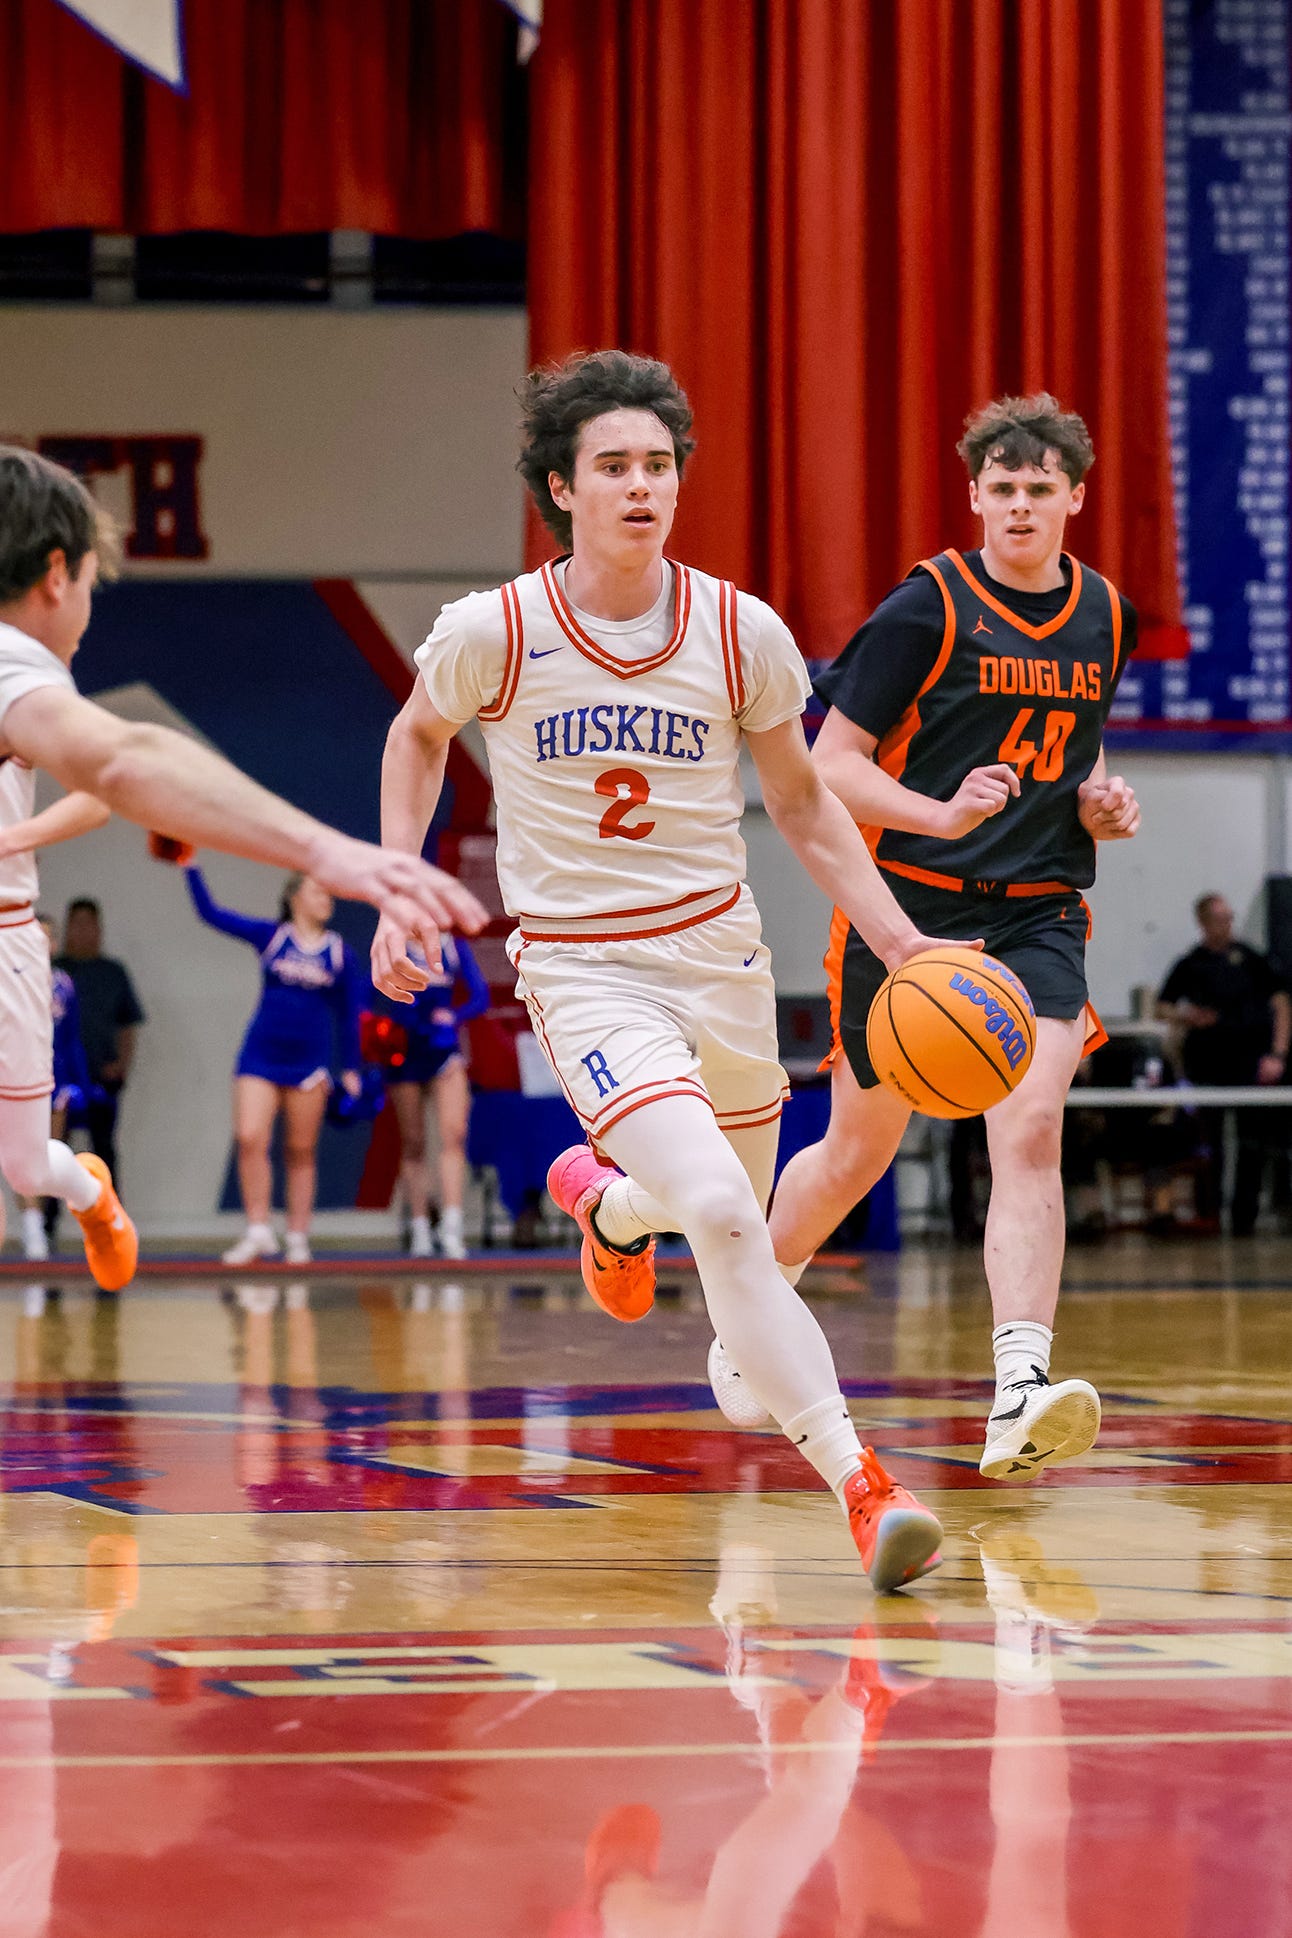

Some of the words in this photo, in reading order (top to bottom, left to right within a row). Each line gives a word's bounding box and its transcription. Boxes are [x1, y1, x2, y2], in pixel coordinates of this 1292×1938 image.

[979, 656, 1101, 701] DOUGLAS
[534, 704, 710, 763] HUSKIES
[998, 707, 1077, 782] 40
[594, 767, 656, 841] 2
[948, 972, 1028, 1072] Wilson
[580, 1049, 621, 1098] R
